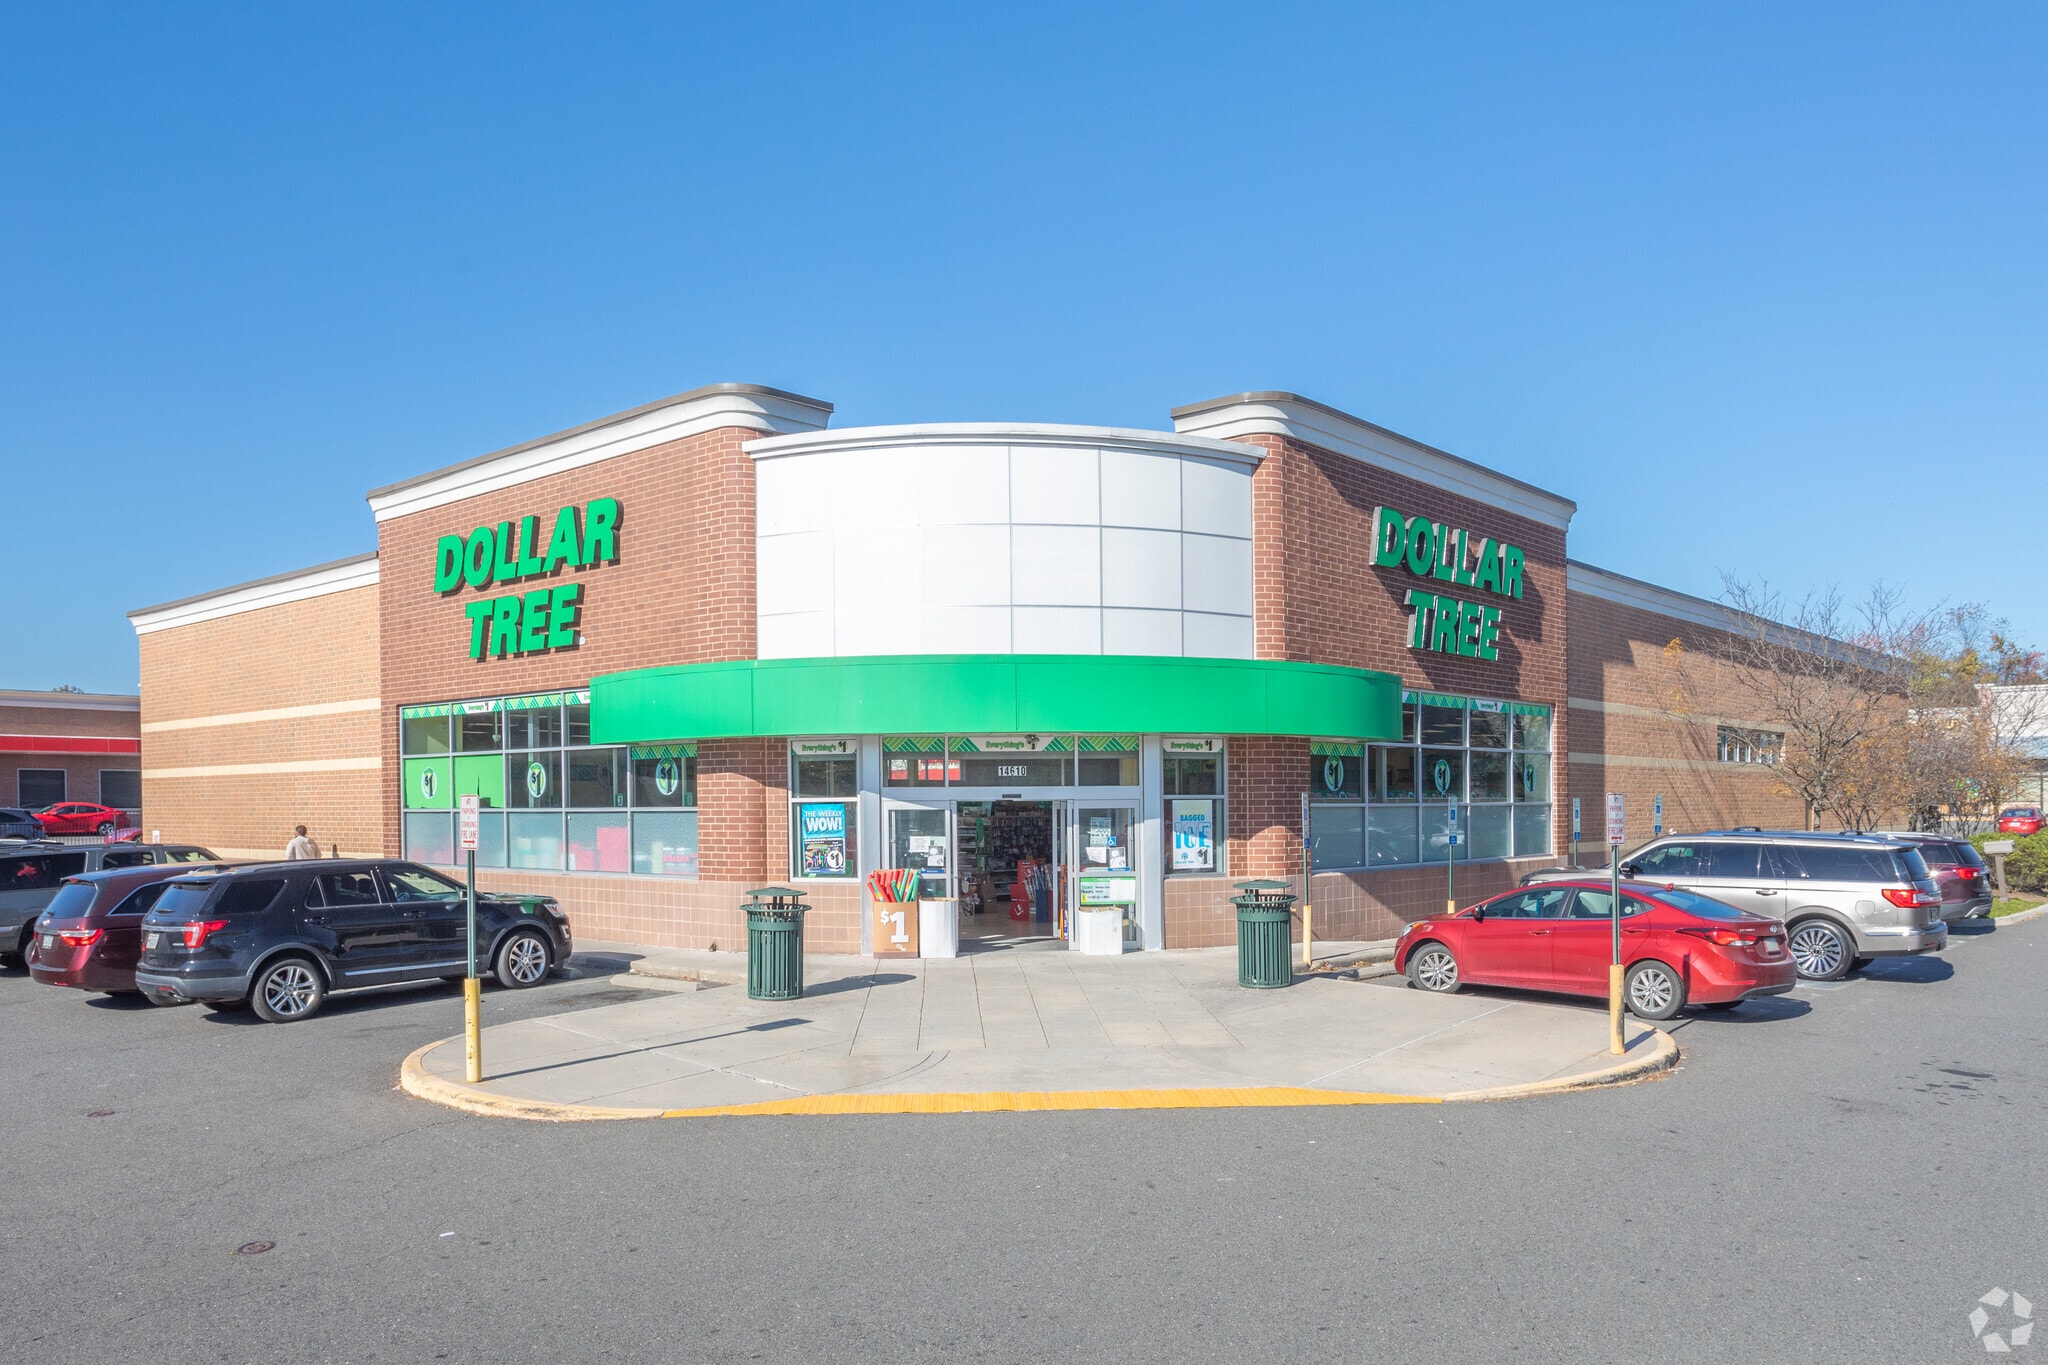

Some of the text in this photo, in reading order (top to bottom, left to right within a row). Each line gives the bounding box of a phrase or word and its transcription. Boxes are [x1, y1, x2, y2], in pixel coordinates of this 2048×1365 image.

[434, 497, 622, 595] DOLLAR
[1369, 506, 1525, 600] DOLLAR
[465, 583, 582, 661] TREE
[1404, 589, 1502, 661] TREE
[838, 741, 847, 752] $1
[986, 741, 1025, 750] Everything's
[1205, 740, 1213, 751] $1
[999, 766, 1026, 776] 14610
[806, 817, 843, 832] WOW!
[1174, 822, 1211, 849] ICE
[830, 853, 840, 866] $1
[1197, 849, 1208, 865] $1
[880, 908, 909, 943] $1
